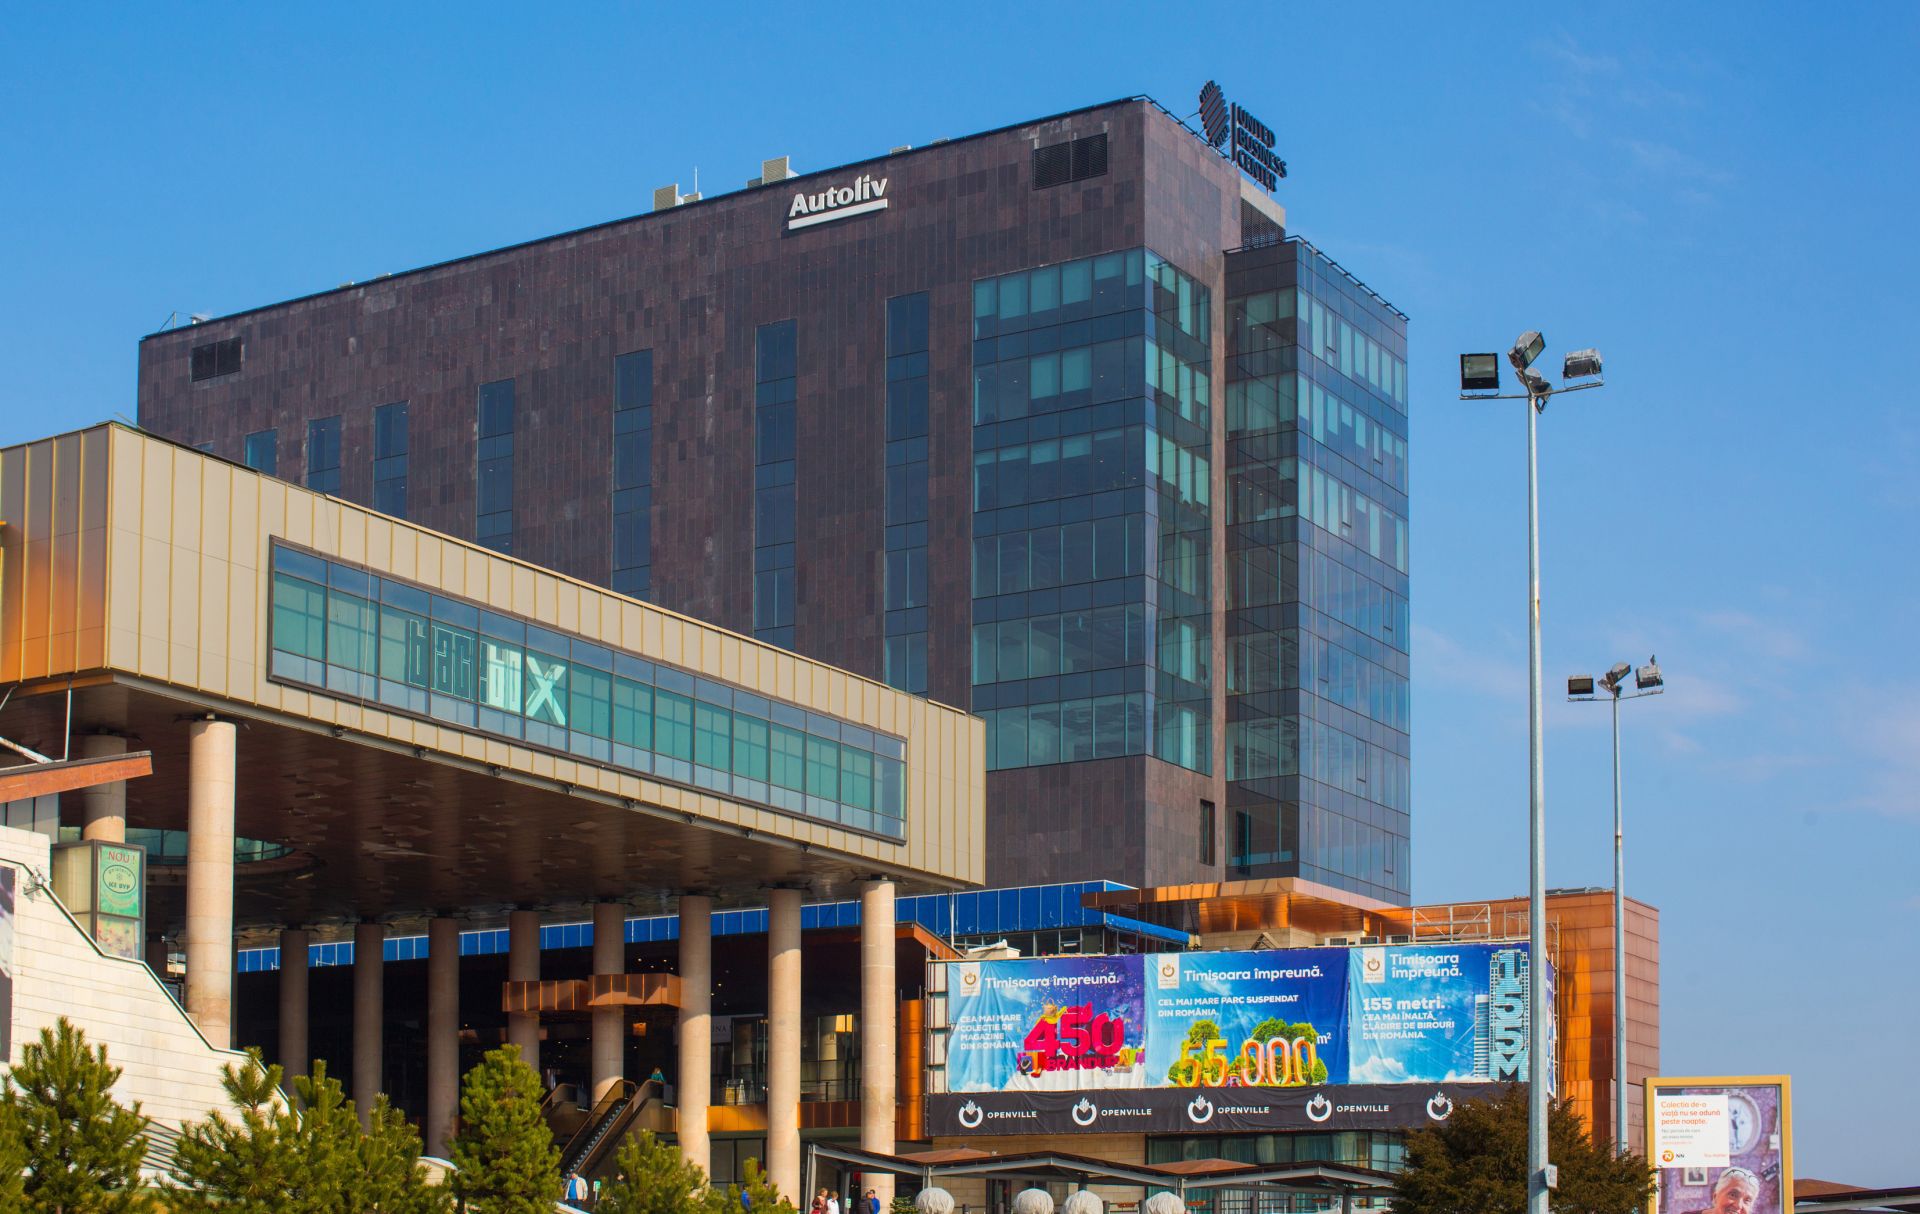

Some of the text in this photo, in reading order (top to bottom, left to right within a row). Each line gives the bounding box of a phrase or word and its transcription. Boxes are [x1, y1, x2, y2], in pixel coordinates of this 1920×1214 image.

[1237, 105, 1276, 149] UNITED
[1237, 127, 1287, 178] BUSINESS
[1237, 149, 1277, 192] CENTER
[789, 175, 888, 217] Autoliv
[1389, 953, 1459, 968] Timișoara
[1184, 969, 1251, 984] Timișoara
[1254, 965, 1324, 982] împreună.
[1391, 964, 1463, 981] împreună.
[985, 971, 1120, 990] Timișoara împreună.
[1158, 994, 1299, 1007] CEL MAI MARE PARC SUSPENDAT
[1363, 995, 1446, 1011] 155 metri.
[960, 1013, 1022, 1023] CEA MAI MARE
[1158, 1009, 1174, 1017] DIN
[1362, 1013, 1381, 1021] CEA
[1382, 1013, 1400, 1021] MAI
[1002, 1023, 1013, 1031] DE
[1023, 1001, 1125, 1058] 450
[1417, 1020, 1455, 1029] BIROURI
[960, 1032, 1004, 1041] MAGAZINE
[1362, 1032, 1379, 1040] DIN
[960, 1042, 976, 1050] DIN
[1101, 1108, 1152, 1117] OPENVILLE
[1217, 1106, 1270, 1114] OPENVILLE
[1336, 1104, 1389, 1113] OPENVILLE
[987, 1110, 1038, 1119] OPENVILLE
